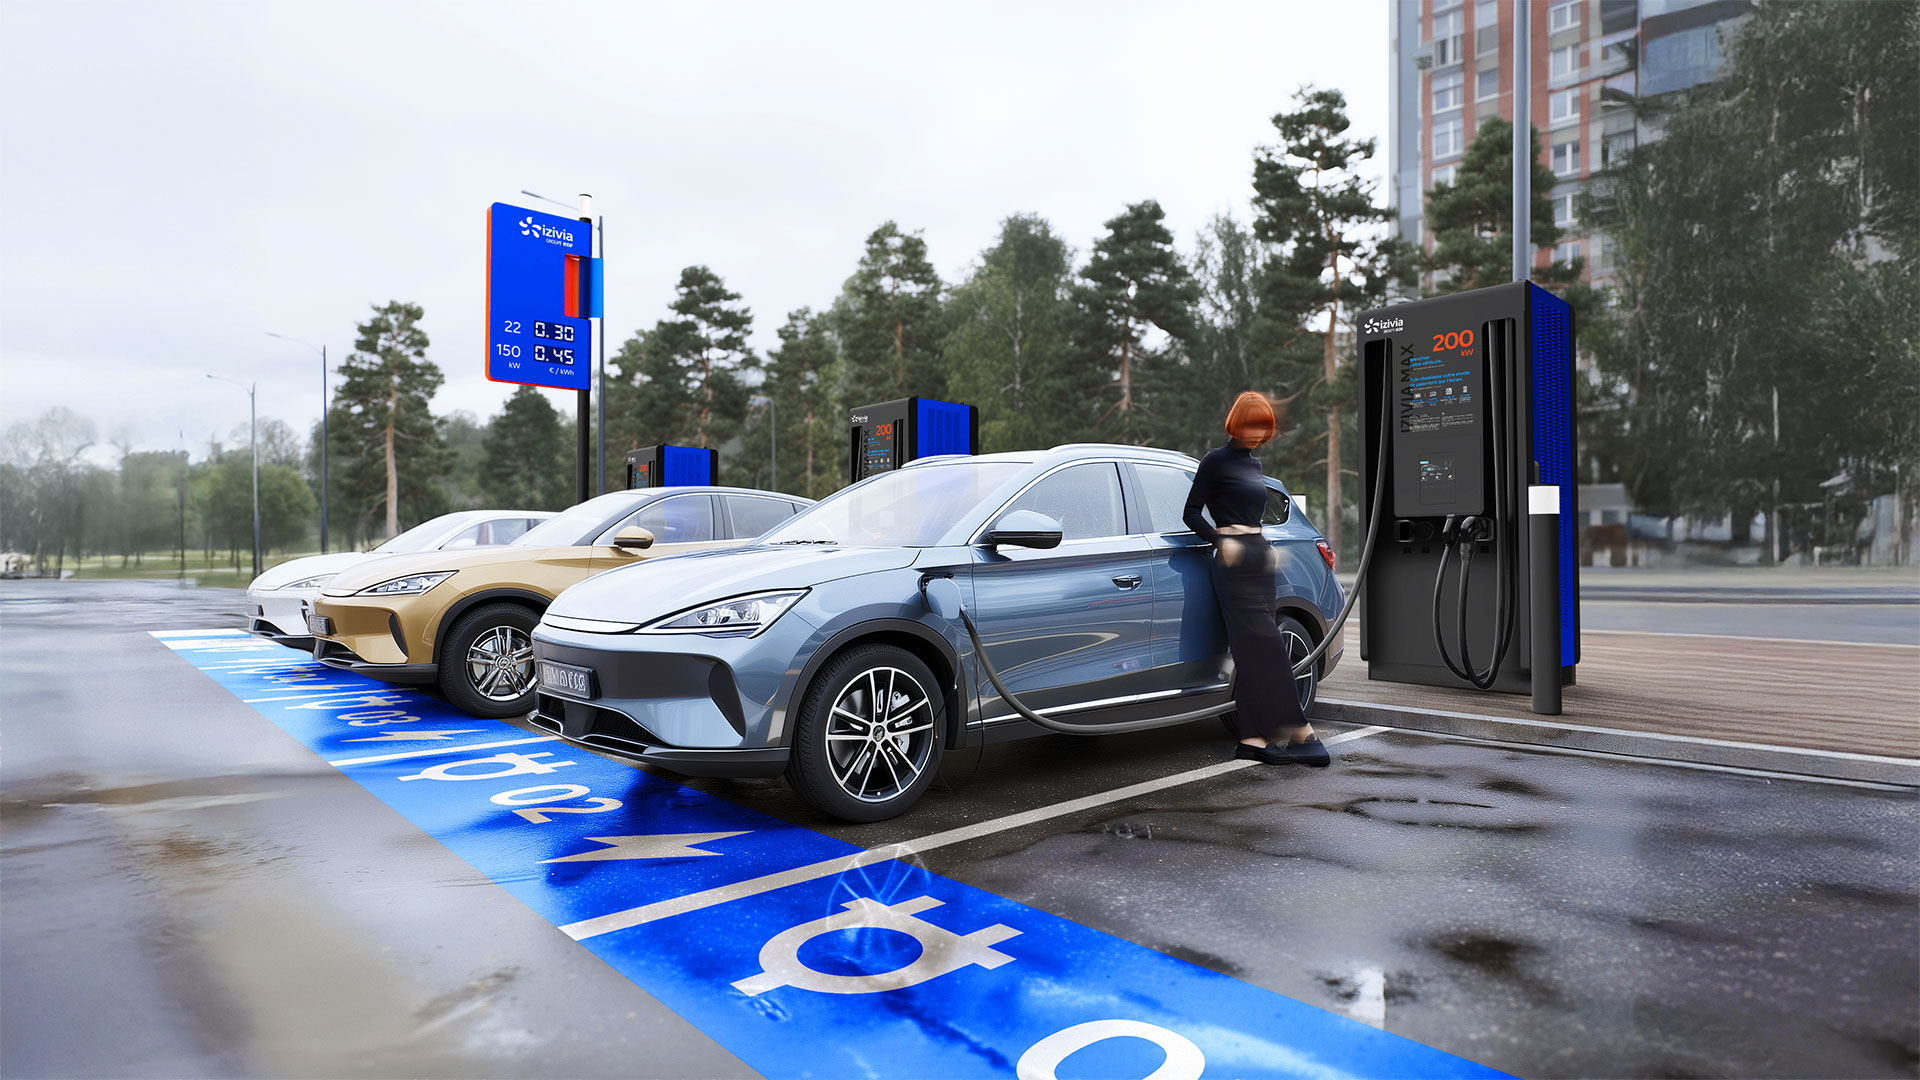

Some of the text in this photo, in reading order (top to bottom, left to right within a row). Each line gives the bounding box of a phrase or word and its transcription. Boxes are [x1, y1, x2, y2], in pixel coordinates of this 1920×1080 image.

[542, 224, 573, 242] izivia
[504, 320, 574, 342] 22 0.30
[1380, 317, 1404, 329] izivia
[1432, 329, 1474, 352] 200
[496, 343, 574, 365] 150 0.45
[1460, 348, 1474, 357] kW
[508, 361, 521, 369] kW
[560, 368, 575, 376] kWh
[875, 423, 892, 436] 200
[336, 710, 421, 726] 03
[489, 784, 623, 824] 02
